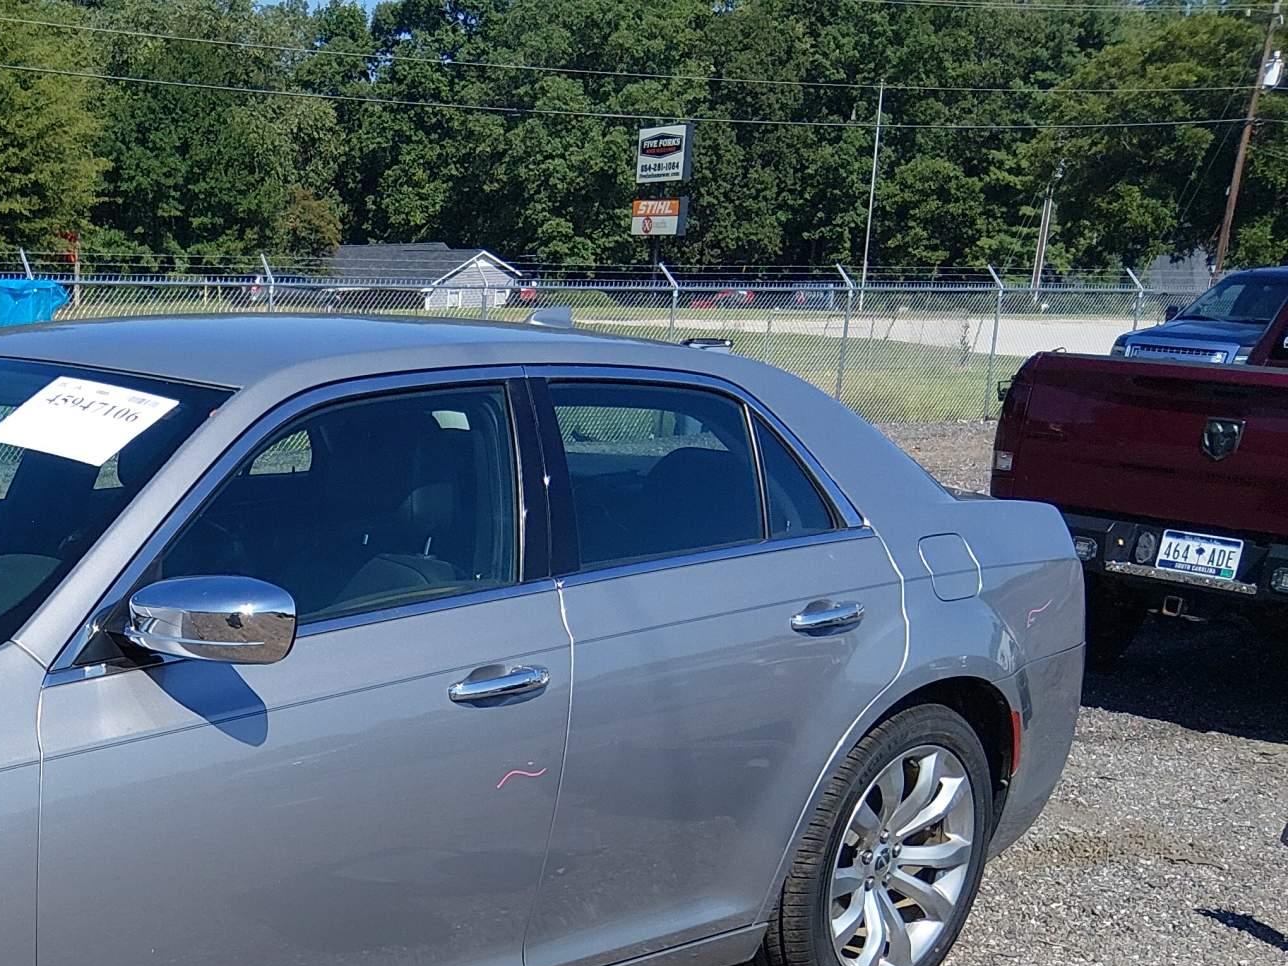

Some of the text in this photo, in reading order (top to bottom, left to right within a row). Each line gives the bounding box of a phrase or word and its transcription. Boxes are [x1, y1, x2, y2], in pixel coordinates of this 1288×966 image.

[643, 137, 681, 149] FIVE FORKS
[637, 200, 673, 214] STIHL
[46, 393, 139, 423] 45947106
[1164, 541, 1237, 569] 464 ADE
[1174, 562, 1216, 574] SOUTH CAROLINA
